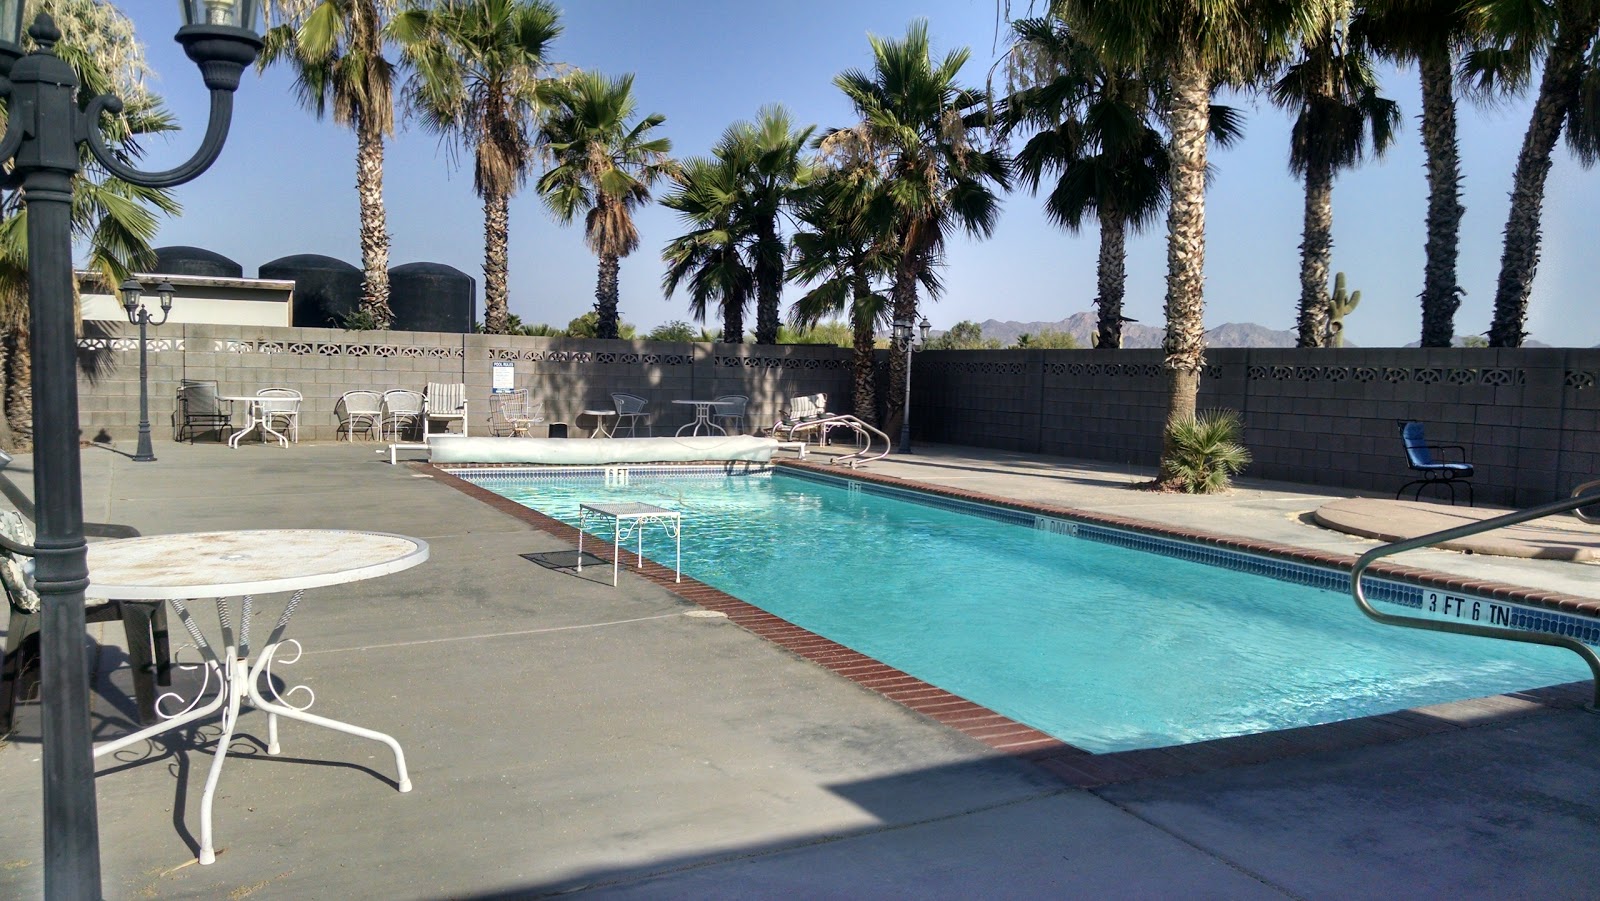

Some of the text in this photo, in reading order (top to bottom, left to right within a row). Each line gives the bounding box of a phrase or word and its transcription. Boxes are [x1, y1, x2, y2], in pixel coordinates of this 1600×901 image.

[1036, 517, 1077, 537] NO DIVING
[1429, 593, 1510, 627] 3 FT 6 IN
